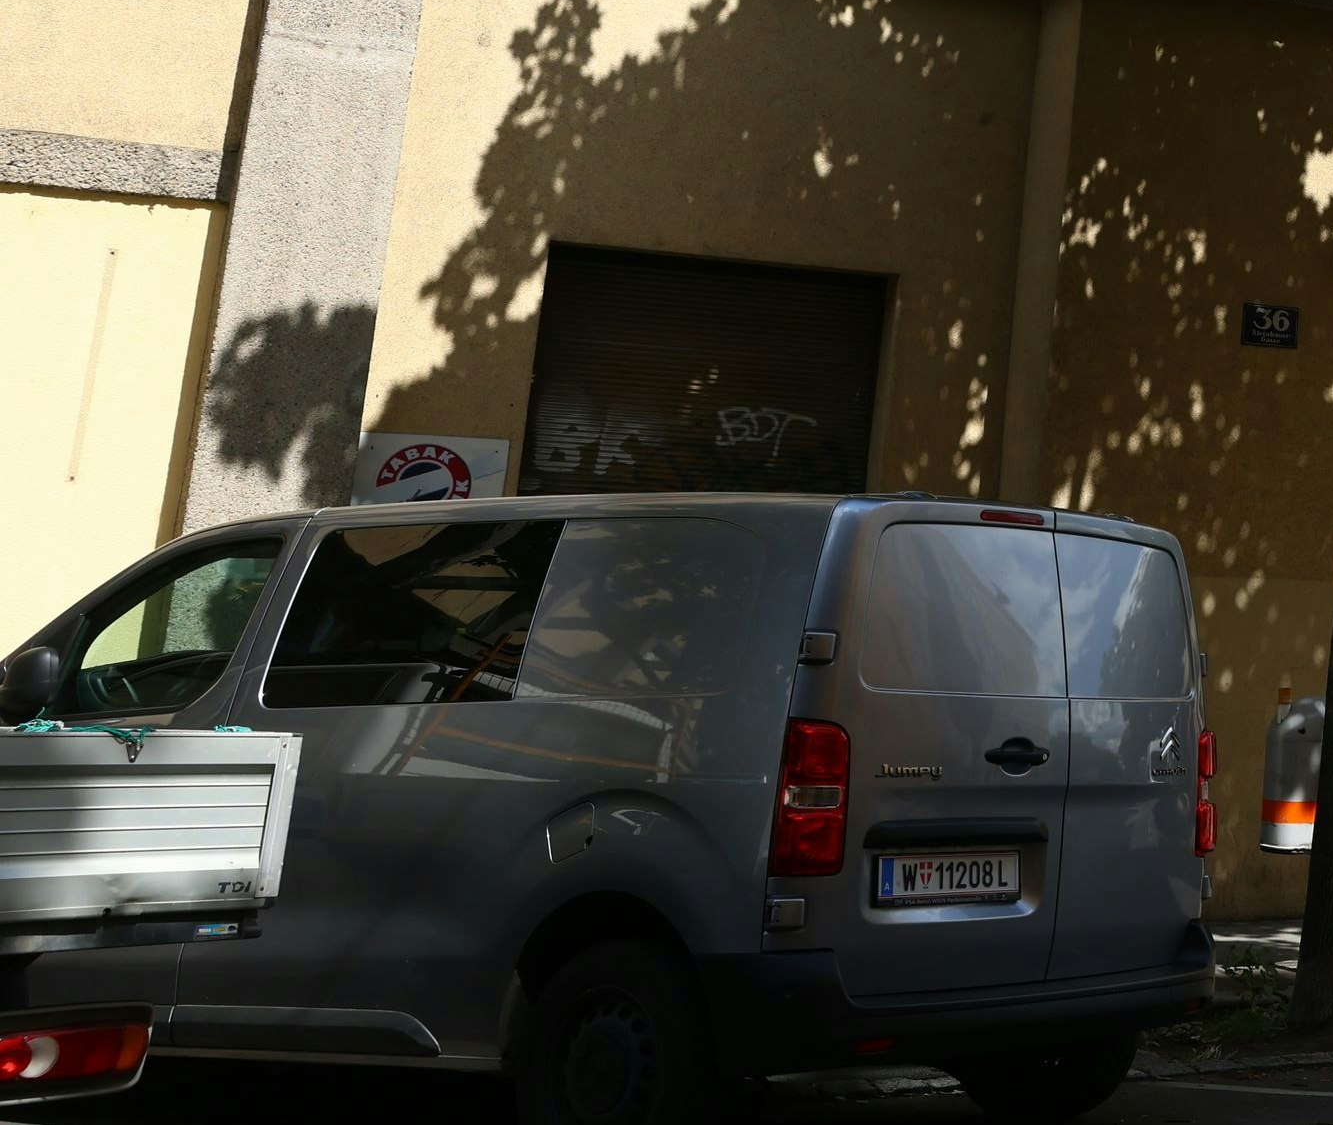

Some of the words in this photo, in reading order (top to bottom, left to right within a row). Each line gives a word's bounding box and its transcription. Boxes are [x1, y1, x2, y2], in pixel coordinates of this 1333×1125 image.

[1252, 307, 1290, 332] 36
[380, 446, 455, 481] TABAK
[218, 881, 252, 893] TDI
[902, 863, 918, 891] W
